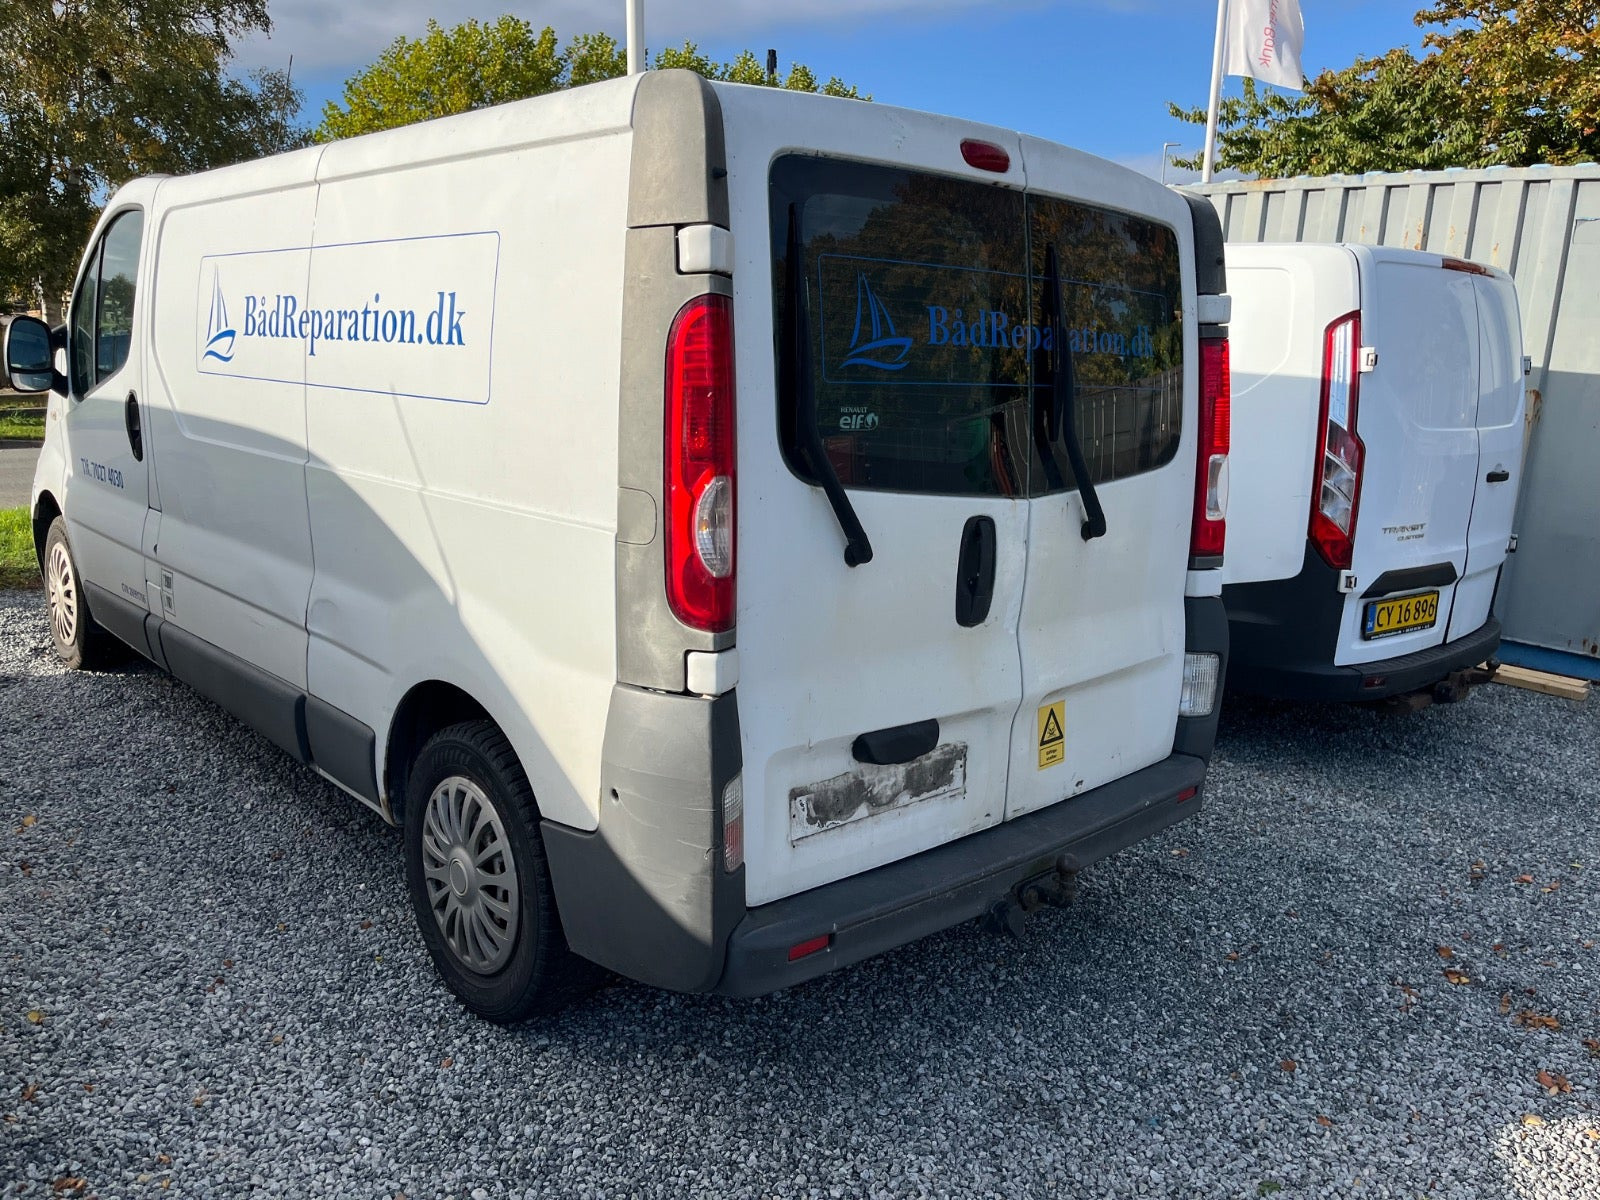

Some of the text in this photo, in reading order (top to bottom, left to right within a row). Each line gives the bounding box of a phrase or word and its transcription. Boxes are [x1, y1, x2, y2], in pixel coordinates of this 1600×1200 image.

[243, 291, 466, 356] BådReparation.dk
[927, 305, 1154, 363] BådRepaation.dk
[840, 414, 865, 429] elf
[91, 462, 107, 483] 7027
[108, 466, 124, 489] 4030
[1377, 597, 1434, 627] CY 16 896
